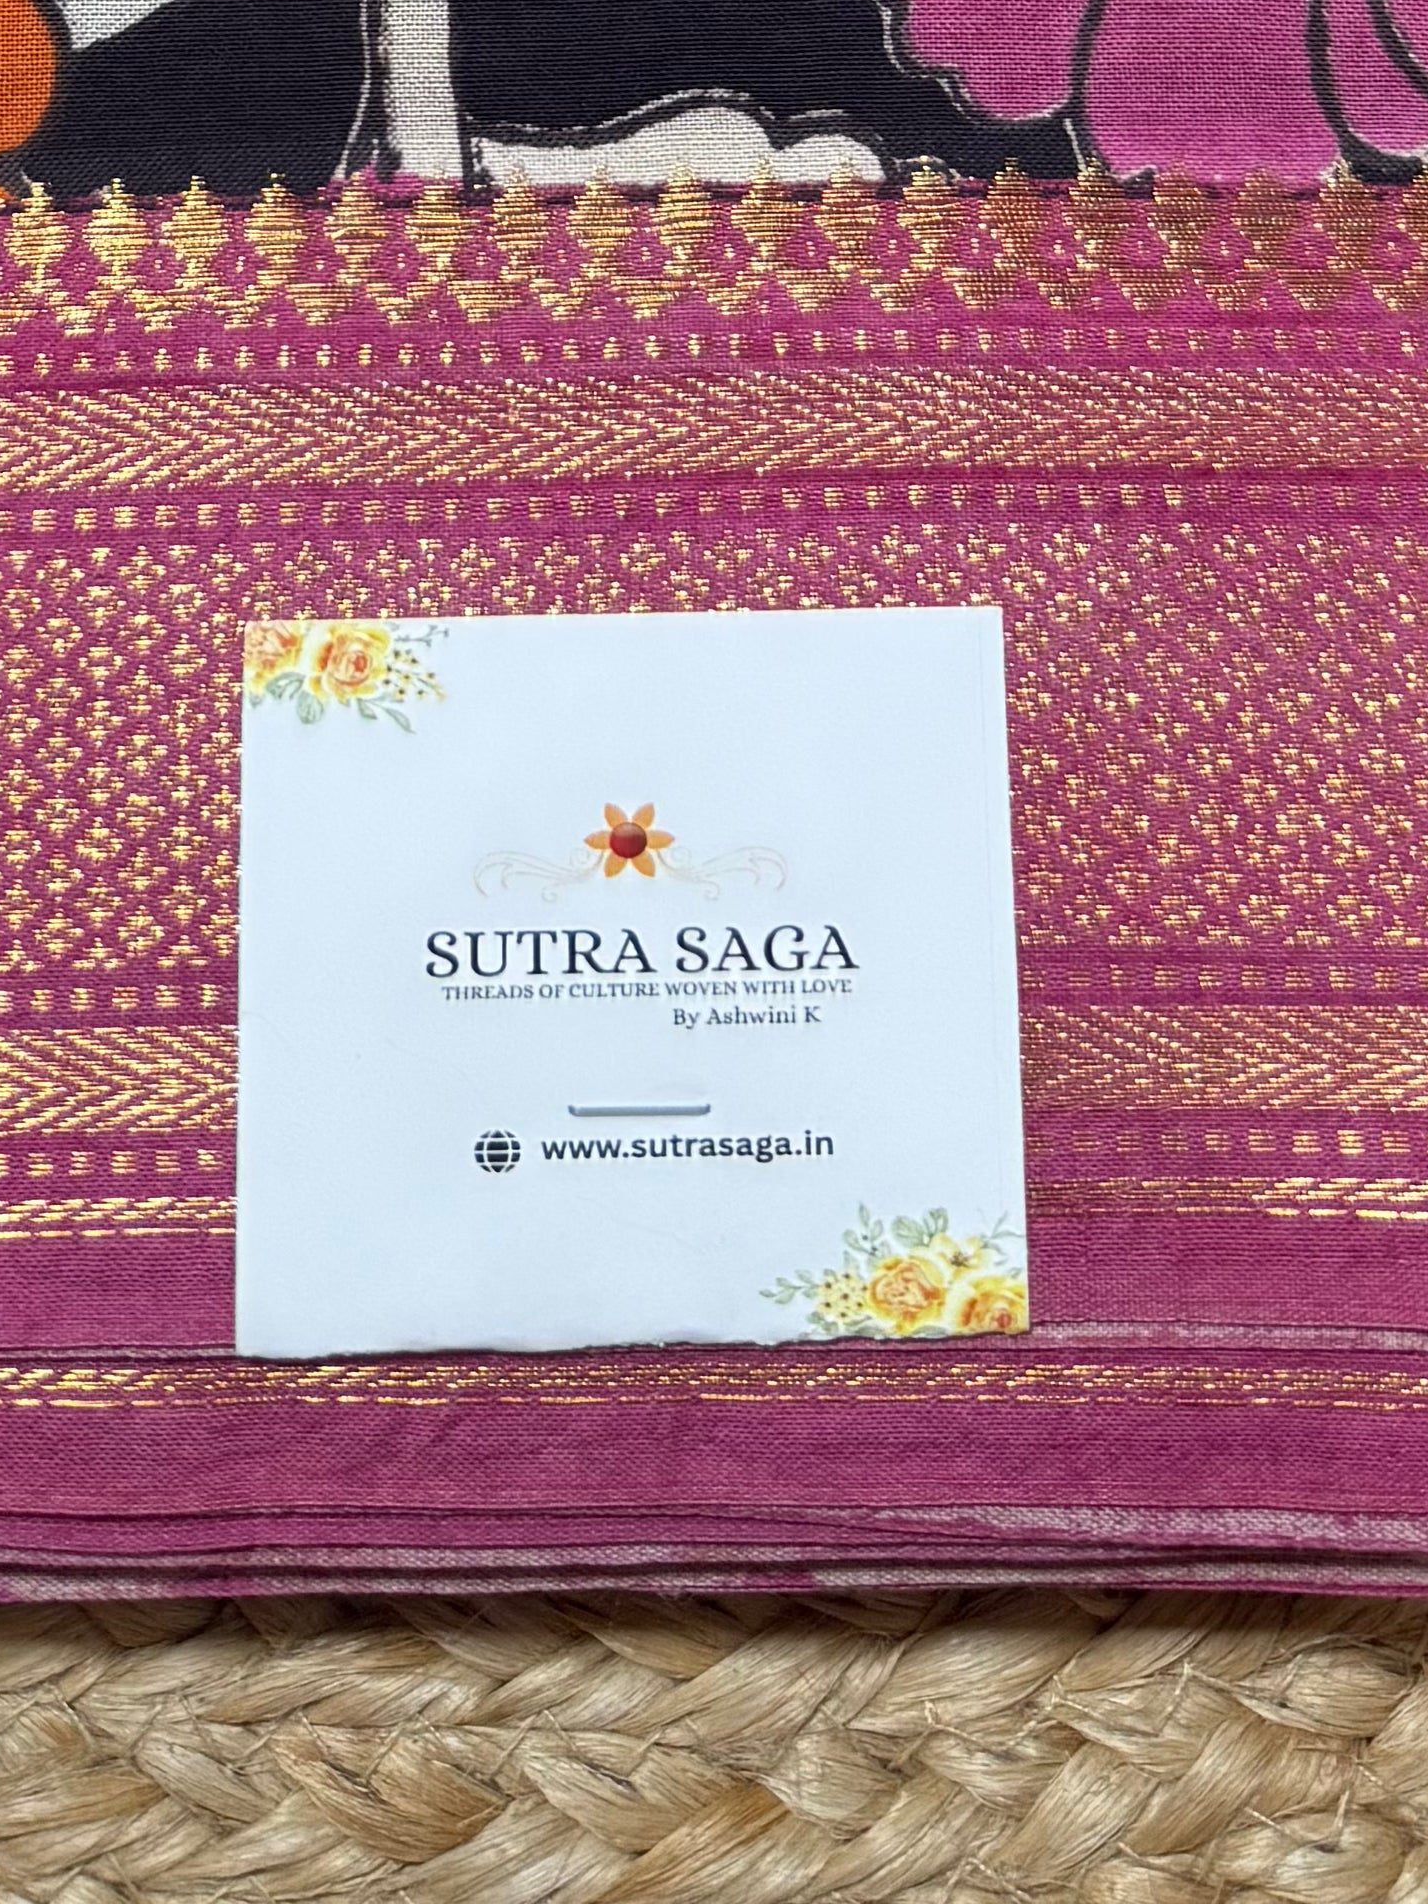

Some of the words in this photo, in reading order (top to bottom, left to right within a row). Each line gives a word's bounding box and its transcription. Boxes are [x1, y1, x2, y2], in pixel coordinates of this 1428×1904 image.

[425, 927, 658, 978] SUTRA
[675, 924, 860, 974] SAGA
[442, 983, 535, 1000] THREADS
[539, 983, 565, 998] OF
[569, 982, 660, 998] CULTURE
[665, 980, 738, 996] WOVEN
[743, 980, 795, 995] WITH
[801, 978, 853, 994] LOVE
[673, 1008, 700, 1030] By
[706, 1004, 797, 1025] Ashwini
[803, 1006, 822, 1023] K
[541, 1129, 834, 1163] www.sutrasaga.in
